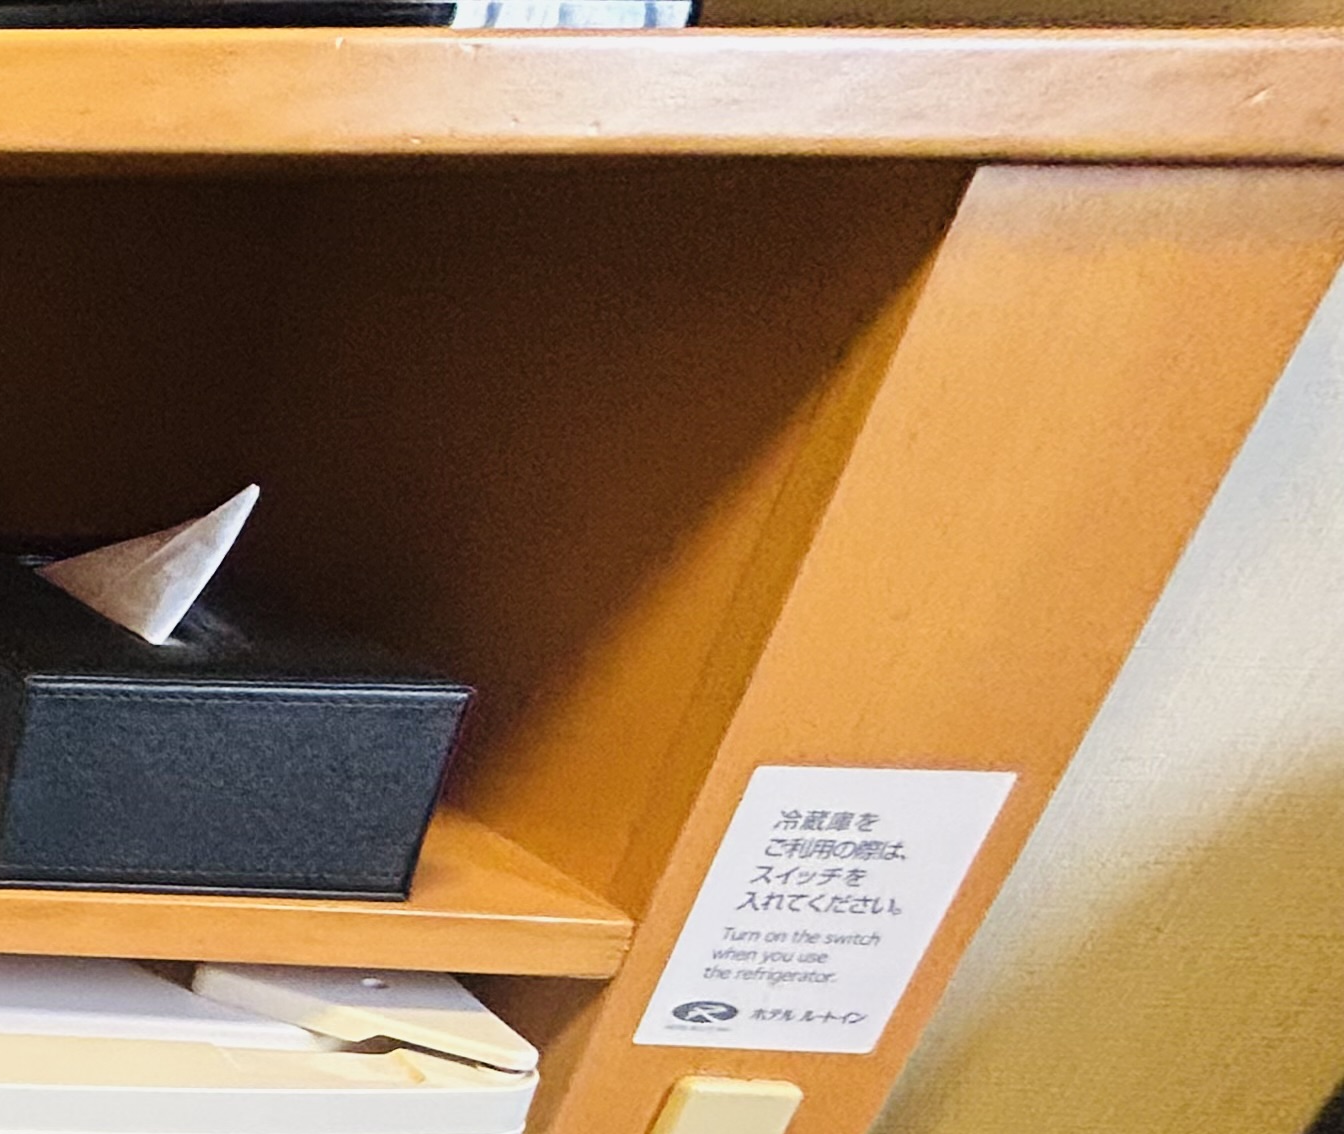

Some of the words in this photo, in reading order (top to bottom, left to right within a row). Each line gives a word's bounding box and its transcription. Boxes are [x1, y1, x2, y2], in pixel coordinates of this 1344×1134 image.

[773, 809, 880, 832] 冷蔵庫を
[750, 865, 868, 887] スイッチを
[735, 891, 903, 916] 入れてください。
[722, 926, 761, 942] Turn
[764, 931, 787, 943] on
[792, 929, 821, 945] the
[824, 931, 881, 947] switch
[712, 948, 756, 961] when
[758, 952, 793, 965] you
[797, 952, 829, 964] use
[703, 966, 732, 980] the
[750, 1008, 793, 1021] ホテル
[799, 1010, 869, 1025] ルートイン
